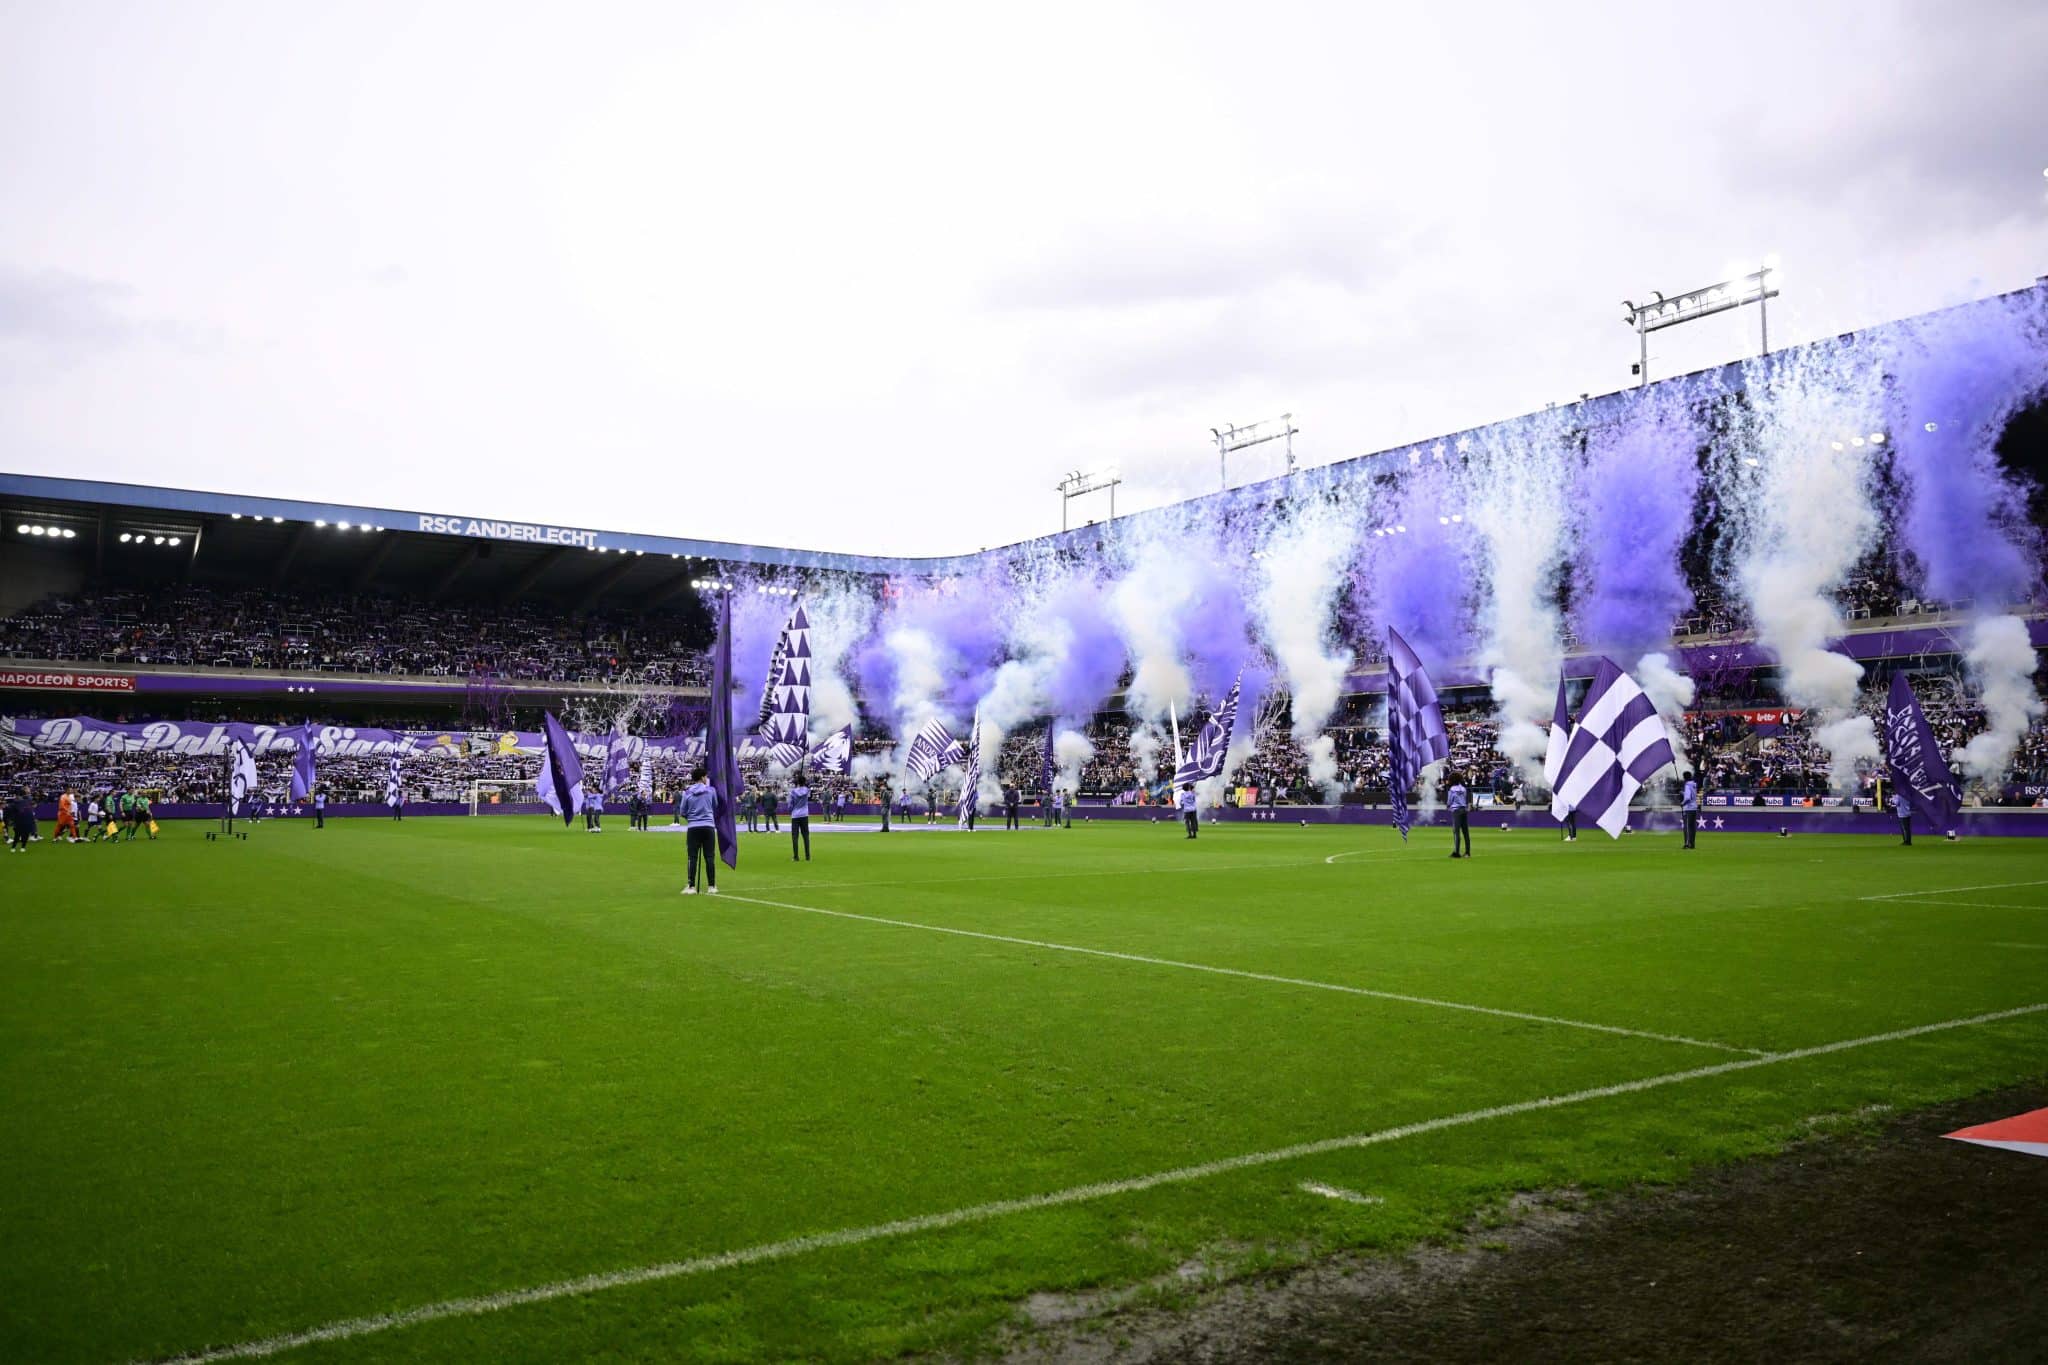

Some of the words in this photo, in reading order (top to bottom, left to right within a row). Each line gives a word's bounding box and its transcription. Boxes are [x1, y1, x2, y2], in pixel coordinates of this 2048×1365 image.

[419, 515, 462, 534] RSC
[465, 520, 598, 547] ANDERLECHT
[142, 722, 229, 756] Pak
